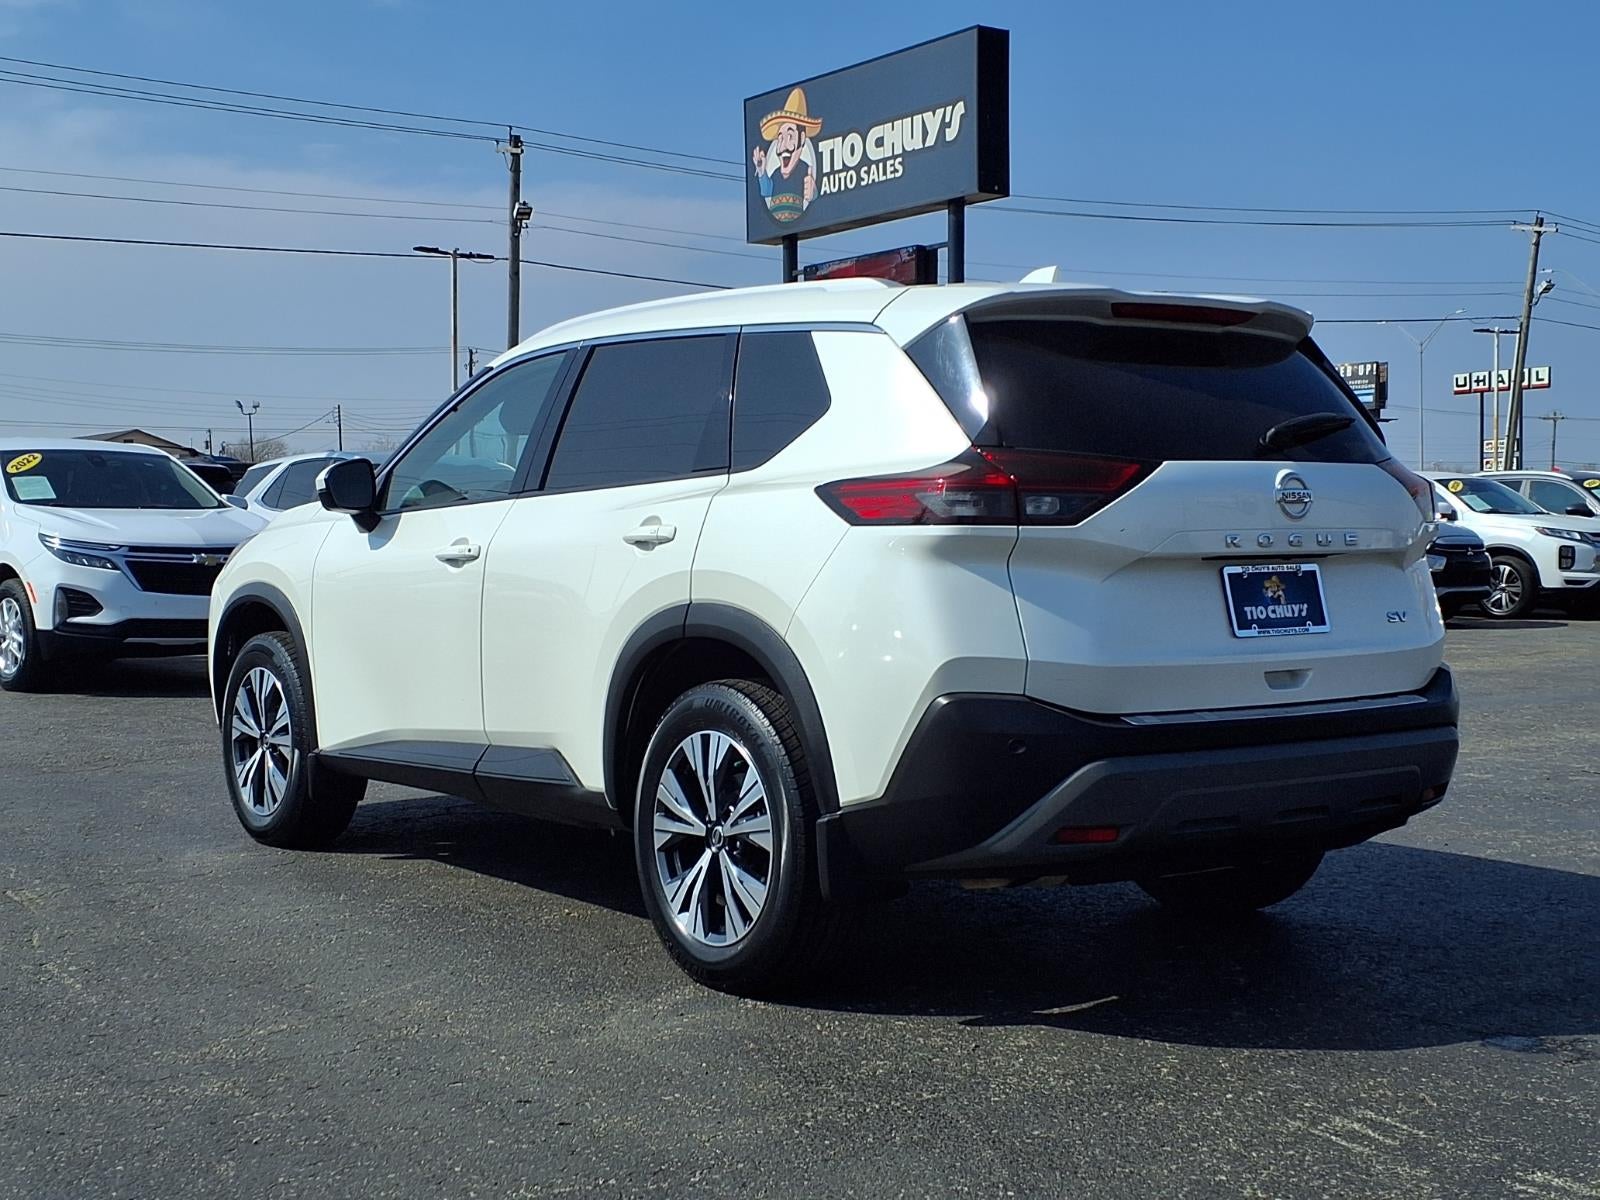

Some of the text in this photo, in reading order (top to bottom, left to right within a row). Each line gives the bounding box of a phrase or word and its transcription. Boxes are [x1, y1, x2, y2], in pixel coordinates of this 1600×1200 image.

[818, 101, 965, 174] TIO CHUY'S
[820, 157, 904, 196] AUTO SALES
[1358, 363, 1377, 376] UP!
[11, 454, 38, 471] 2022
[1281, 491, 1312, 499] NISSAN
[1225, 532, 1360, 548] ROGUE
[1271, 564, 1285, 572] AUTO
[1244, 603, 1308, 620] TIO CHUY'S
[1386, 611, 1406, 623] SV
